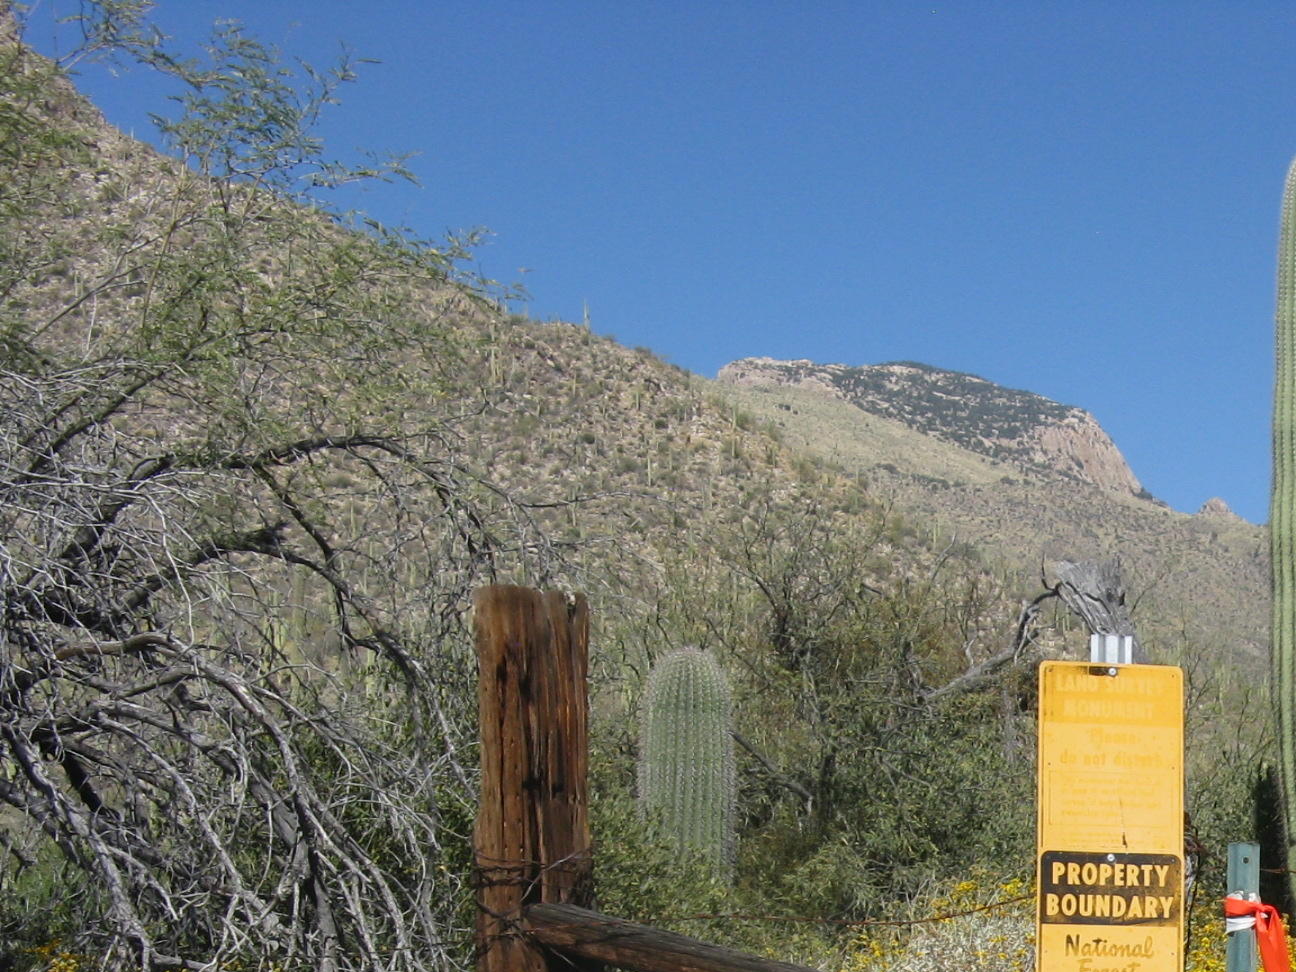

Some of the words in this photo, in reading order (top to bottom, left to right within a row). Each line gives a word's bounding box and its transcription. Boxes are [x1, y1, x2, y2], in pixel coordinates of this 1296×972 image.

[1056, 674, 1099, 692] LAND
[1052, 862, 1169, 887] PROPERTY
[1046, 893, 1173, 918] BOUNDARY
[1065, 934, 1154, 959] National
